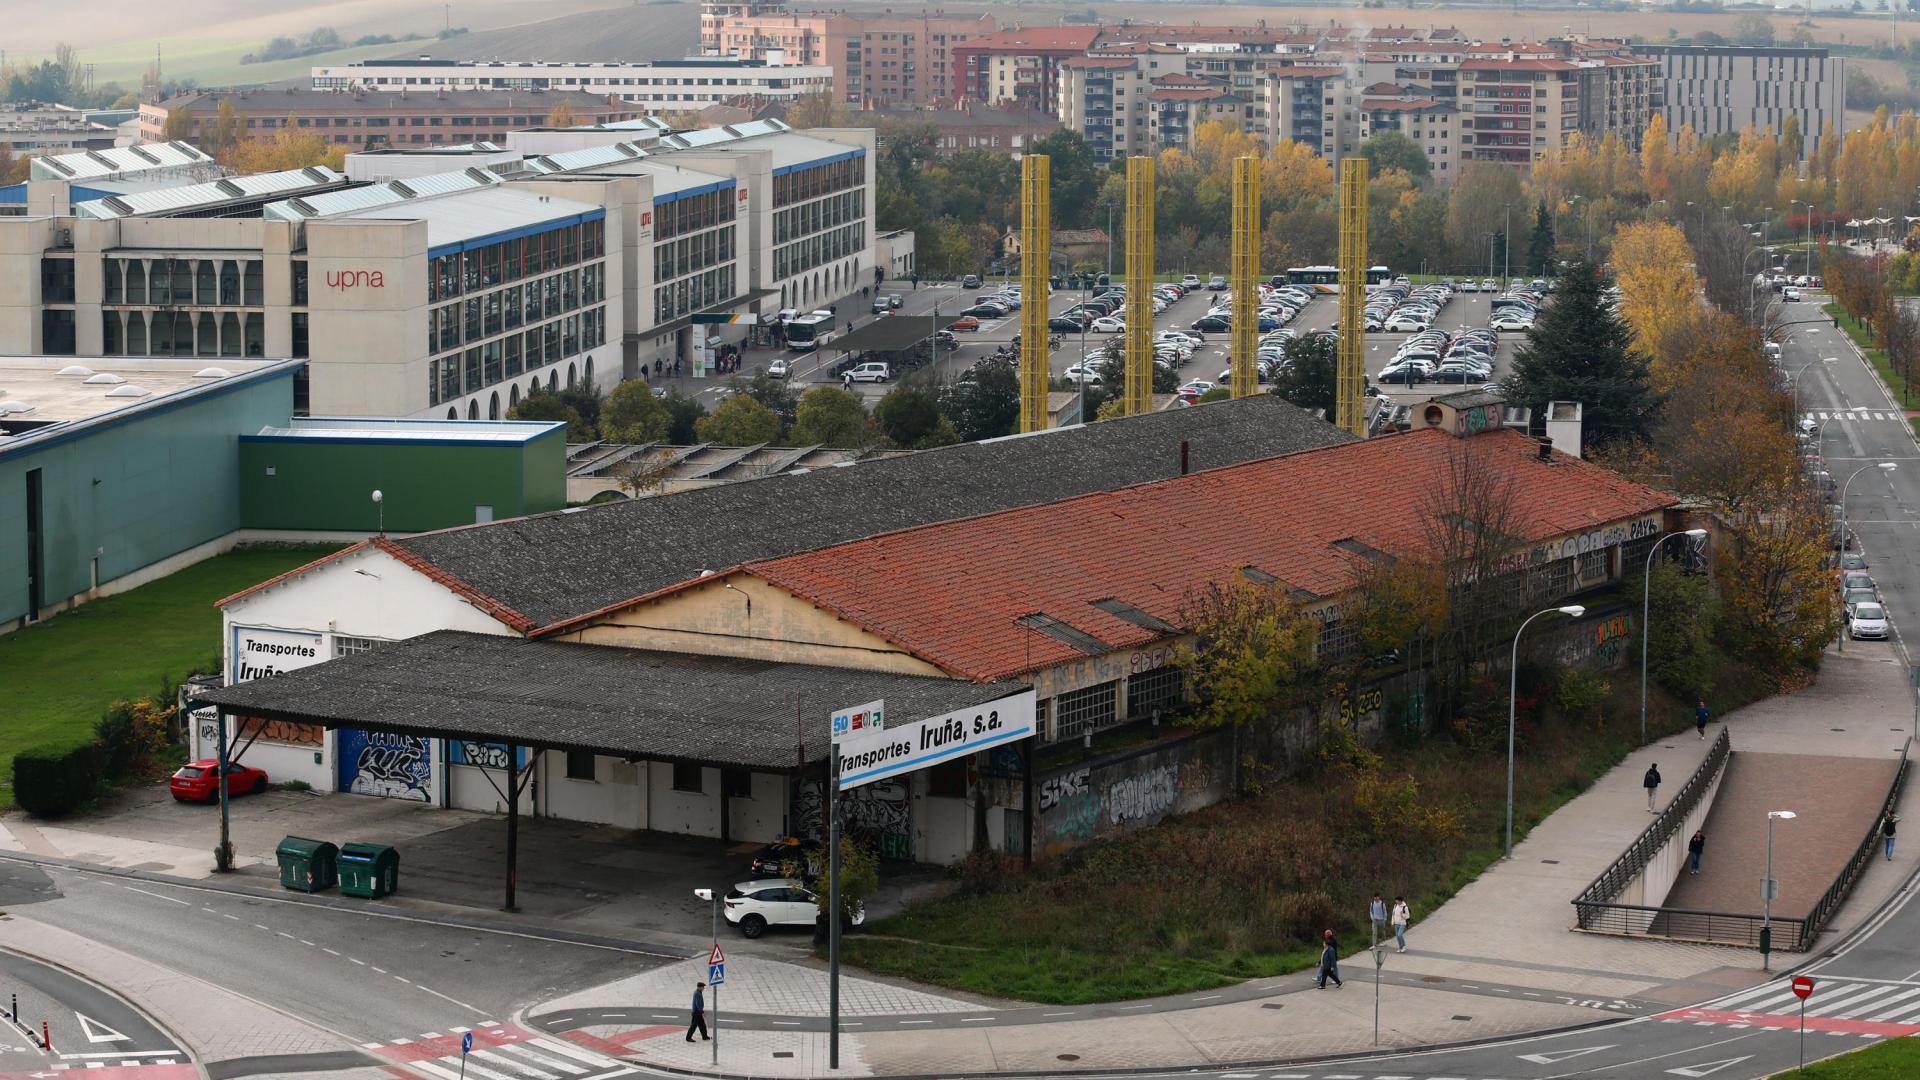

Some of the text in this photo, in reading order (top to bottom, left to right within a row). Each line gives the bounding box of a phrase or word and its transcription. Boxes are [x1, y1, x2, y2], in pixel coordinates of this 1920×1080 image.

[326, 270, 384, 292] upna
[246, 639, 315, 657] Transportes
[839, 711, 1002, 772] Transportes Iruña, s.a.
